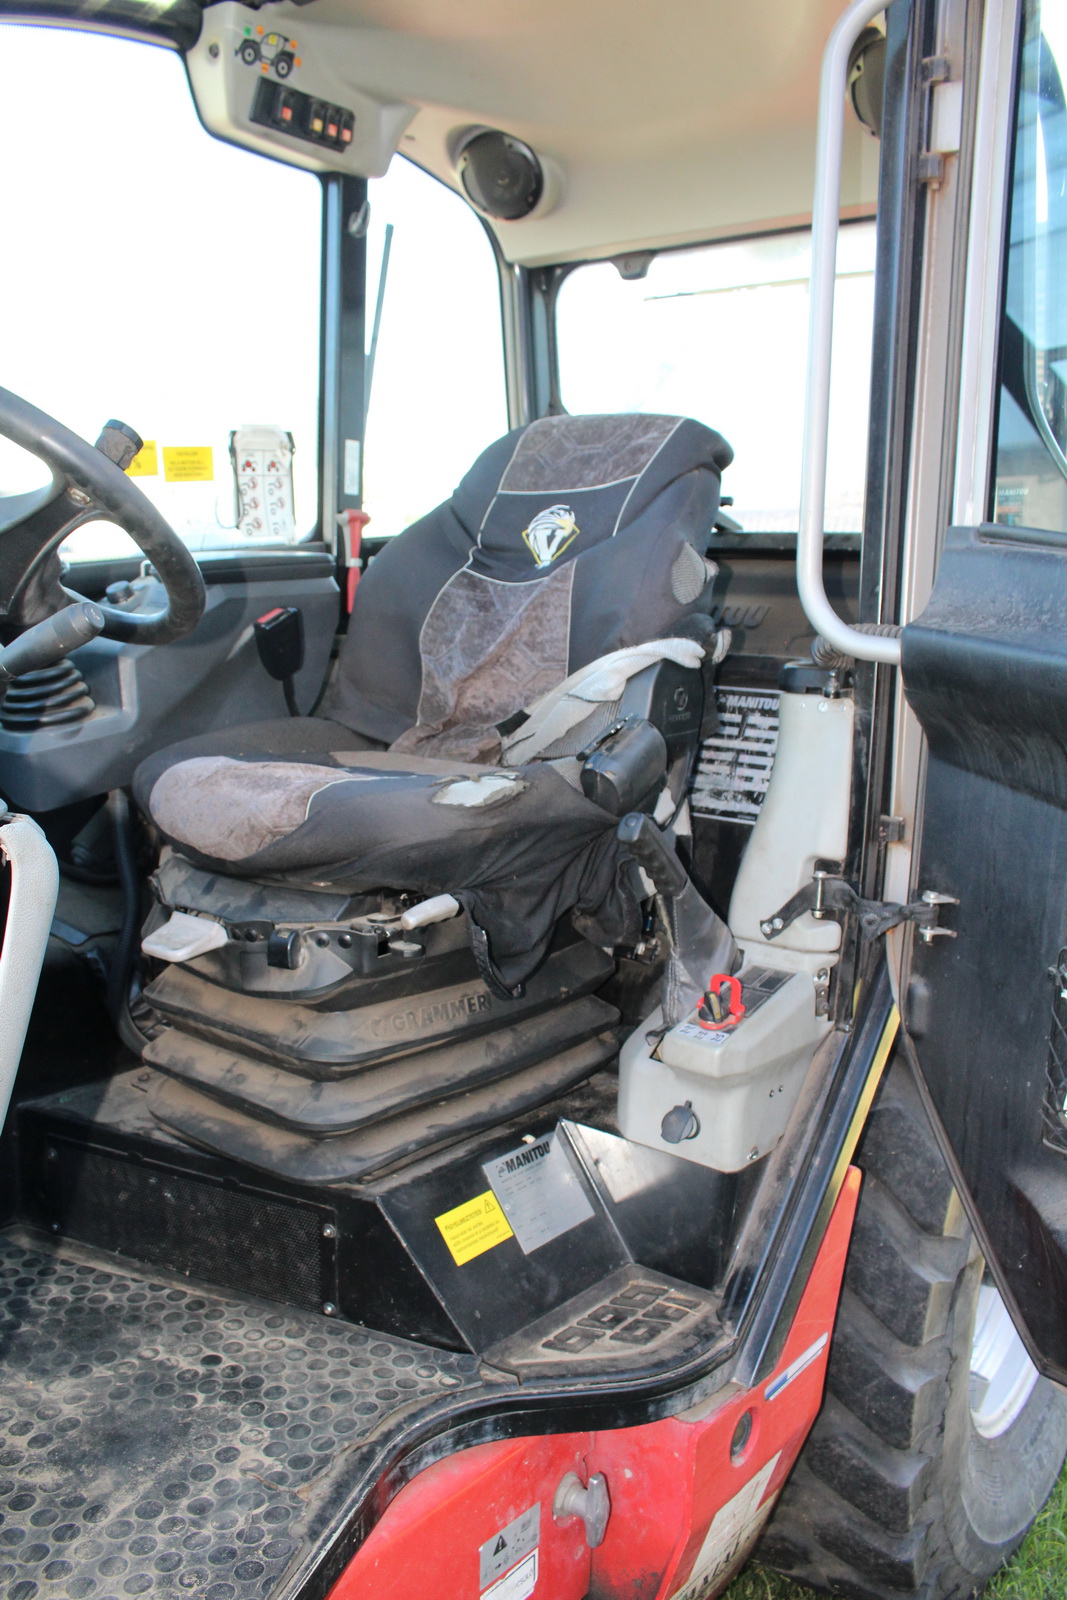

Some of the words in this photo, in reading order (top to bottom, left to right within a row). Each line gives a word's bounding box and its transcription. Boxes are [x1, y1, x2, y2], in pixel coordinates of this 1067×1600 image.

[726, 694, 780, 711] MANITOU
[391, 993, 490, 1032] GRAMMER
[505, 1141, 551, 1174] MANITOU
